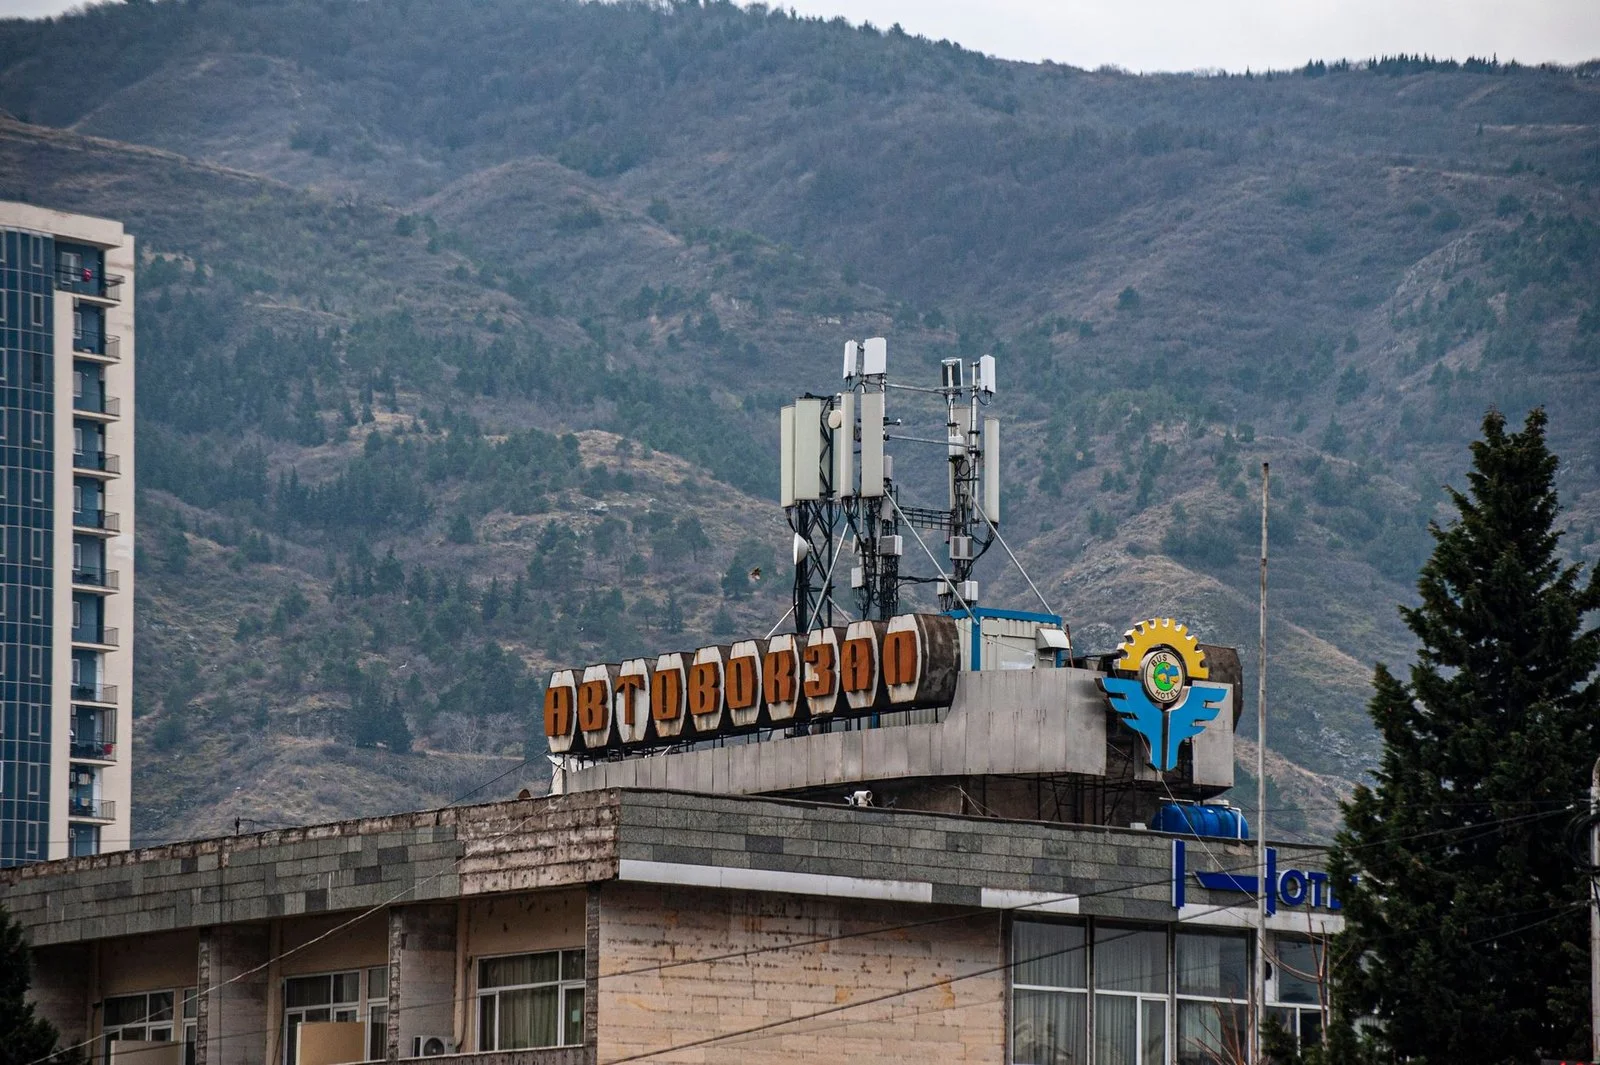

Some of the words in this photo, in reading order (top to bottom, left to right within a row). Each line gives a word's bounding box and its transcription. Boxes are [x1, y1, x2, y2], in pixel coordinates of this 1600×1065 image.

[543, 629, 917, 737] АВТОВОКЗАЛ
[1151, 655, 1168, 667] BUS
[1155, 688, 1179, 699] HOTEL
[1172, 839, 1360, 916] HOT
